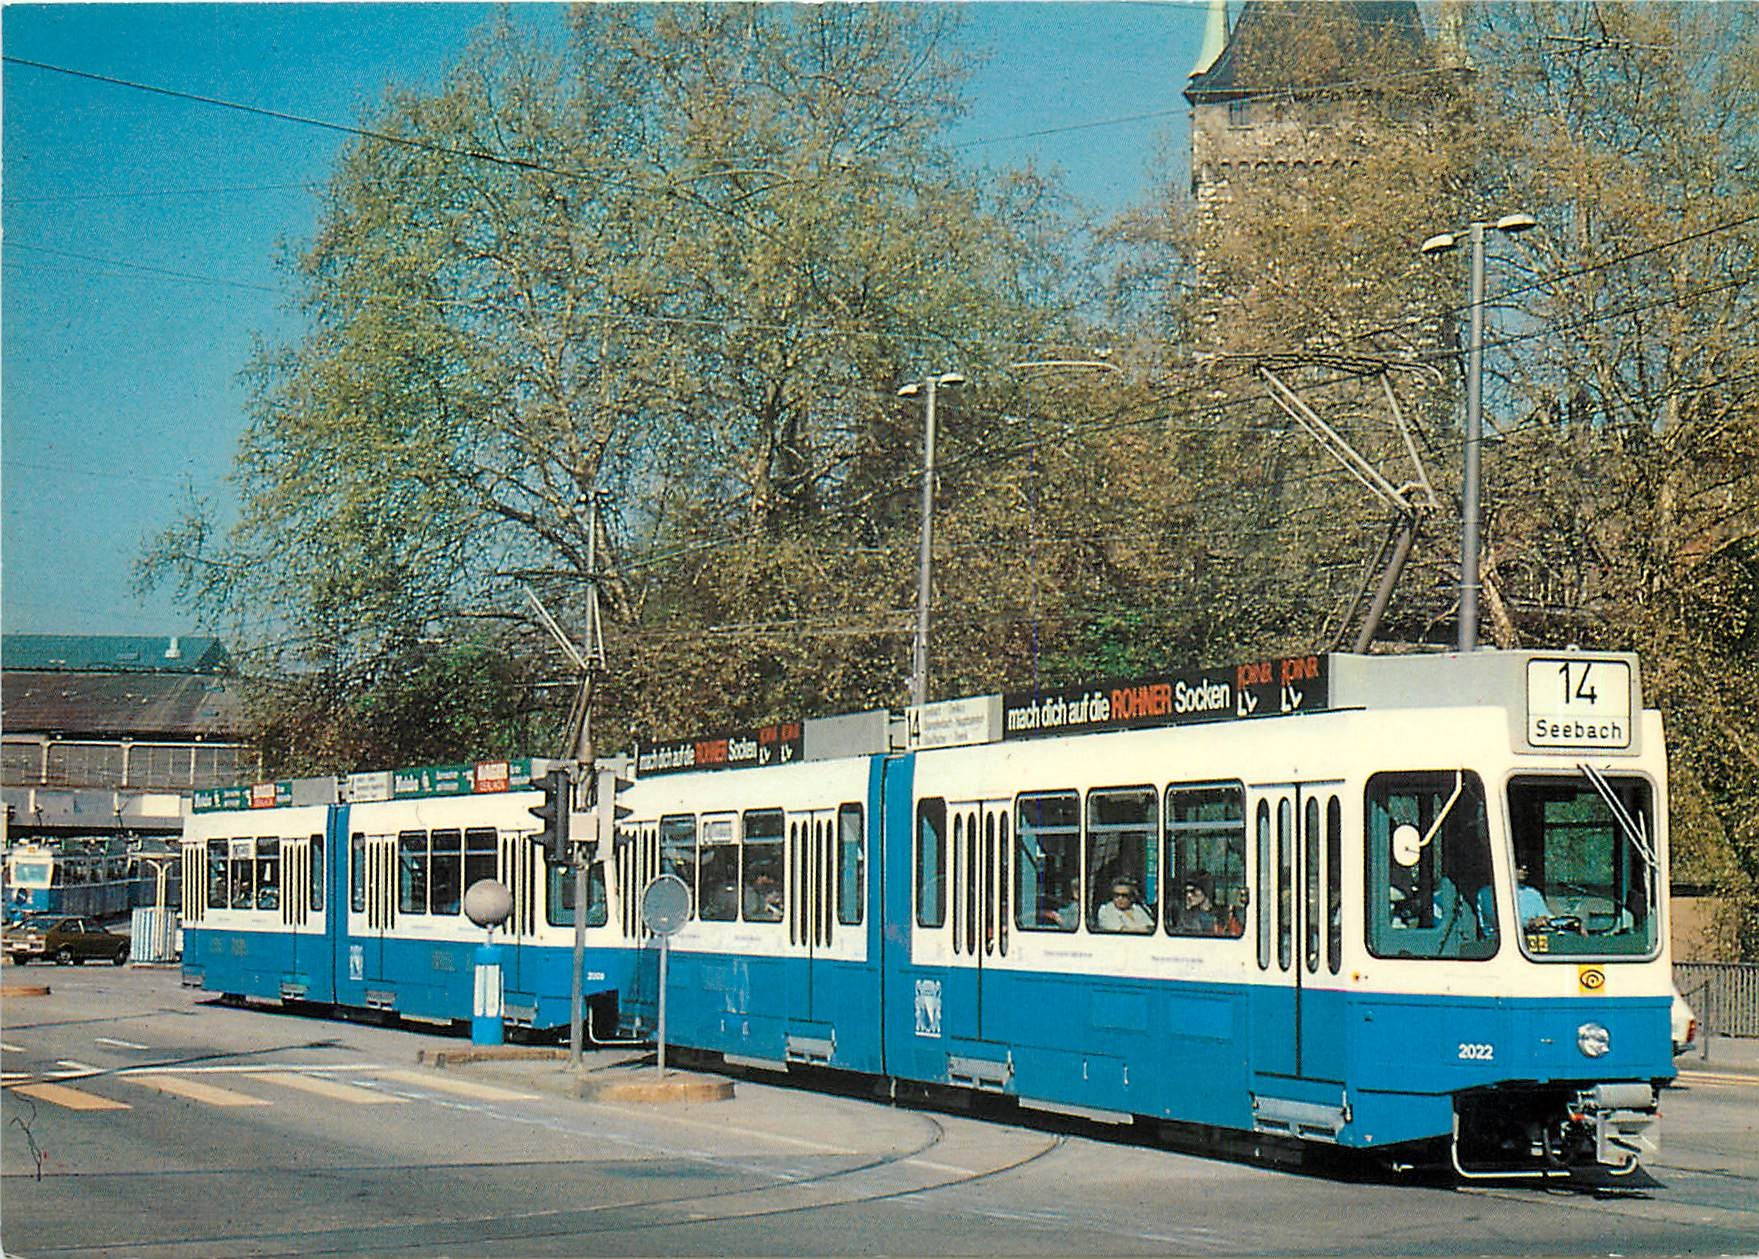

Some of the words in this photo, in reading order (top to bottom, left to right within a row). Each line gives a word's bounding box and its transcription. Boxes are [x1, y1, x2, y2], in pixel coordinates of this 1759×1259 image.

[1559, 662, 1597, 704] 14
[1008, 699, 1040, 730] mach
[1041, 696, 1067, 727] dich
[1068, 693, 1089, 725] auf
[1089, 691, 1110, 722] die
[1111, 683, 1172, 720] ROHNER
[1175, 679, 1230, 713] Socken
[1536, 719, 1622, 739] Seebach
[1458, 1043, 1494, 1060] 2022
